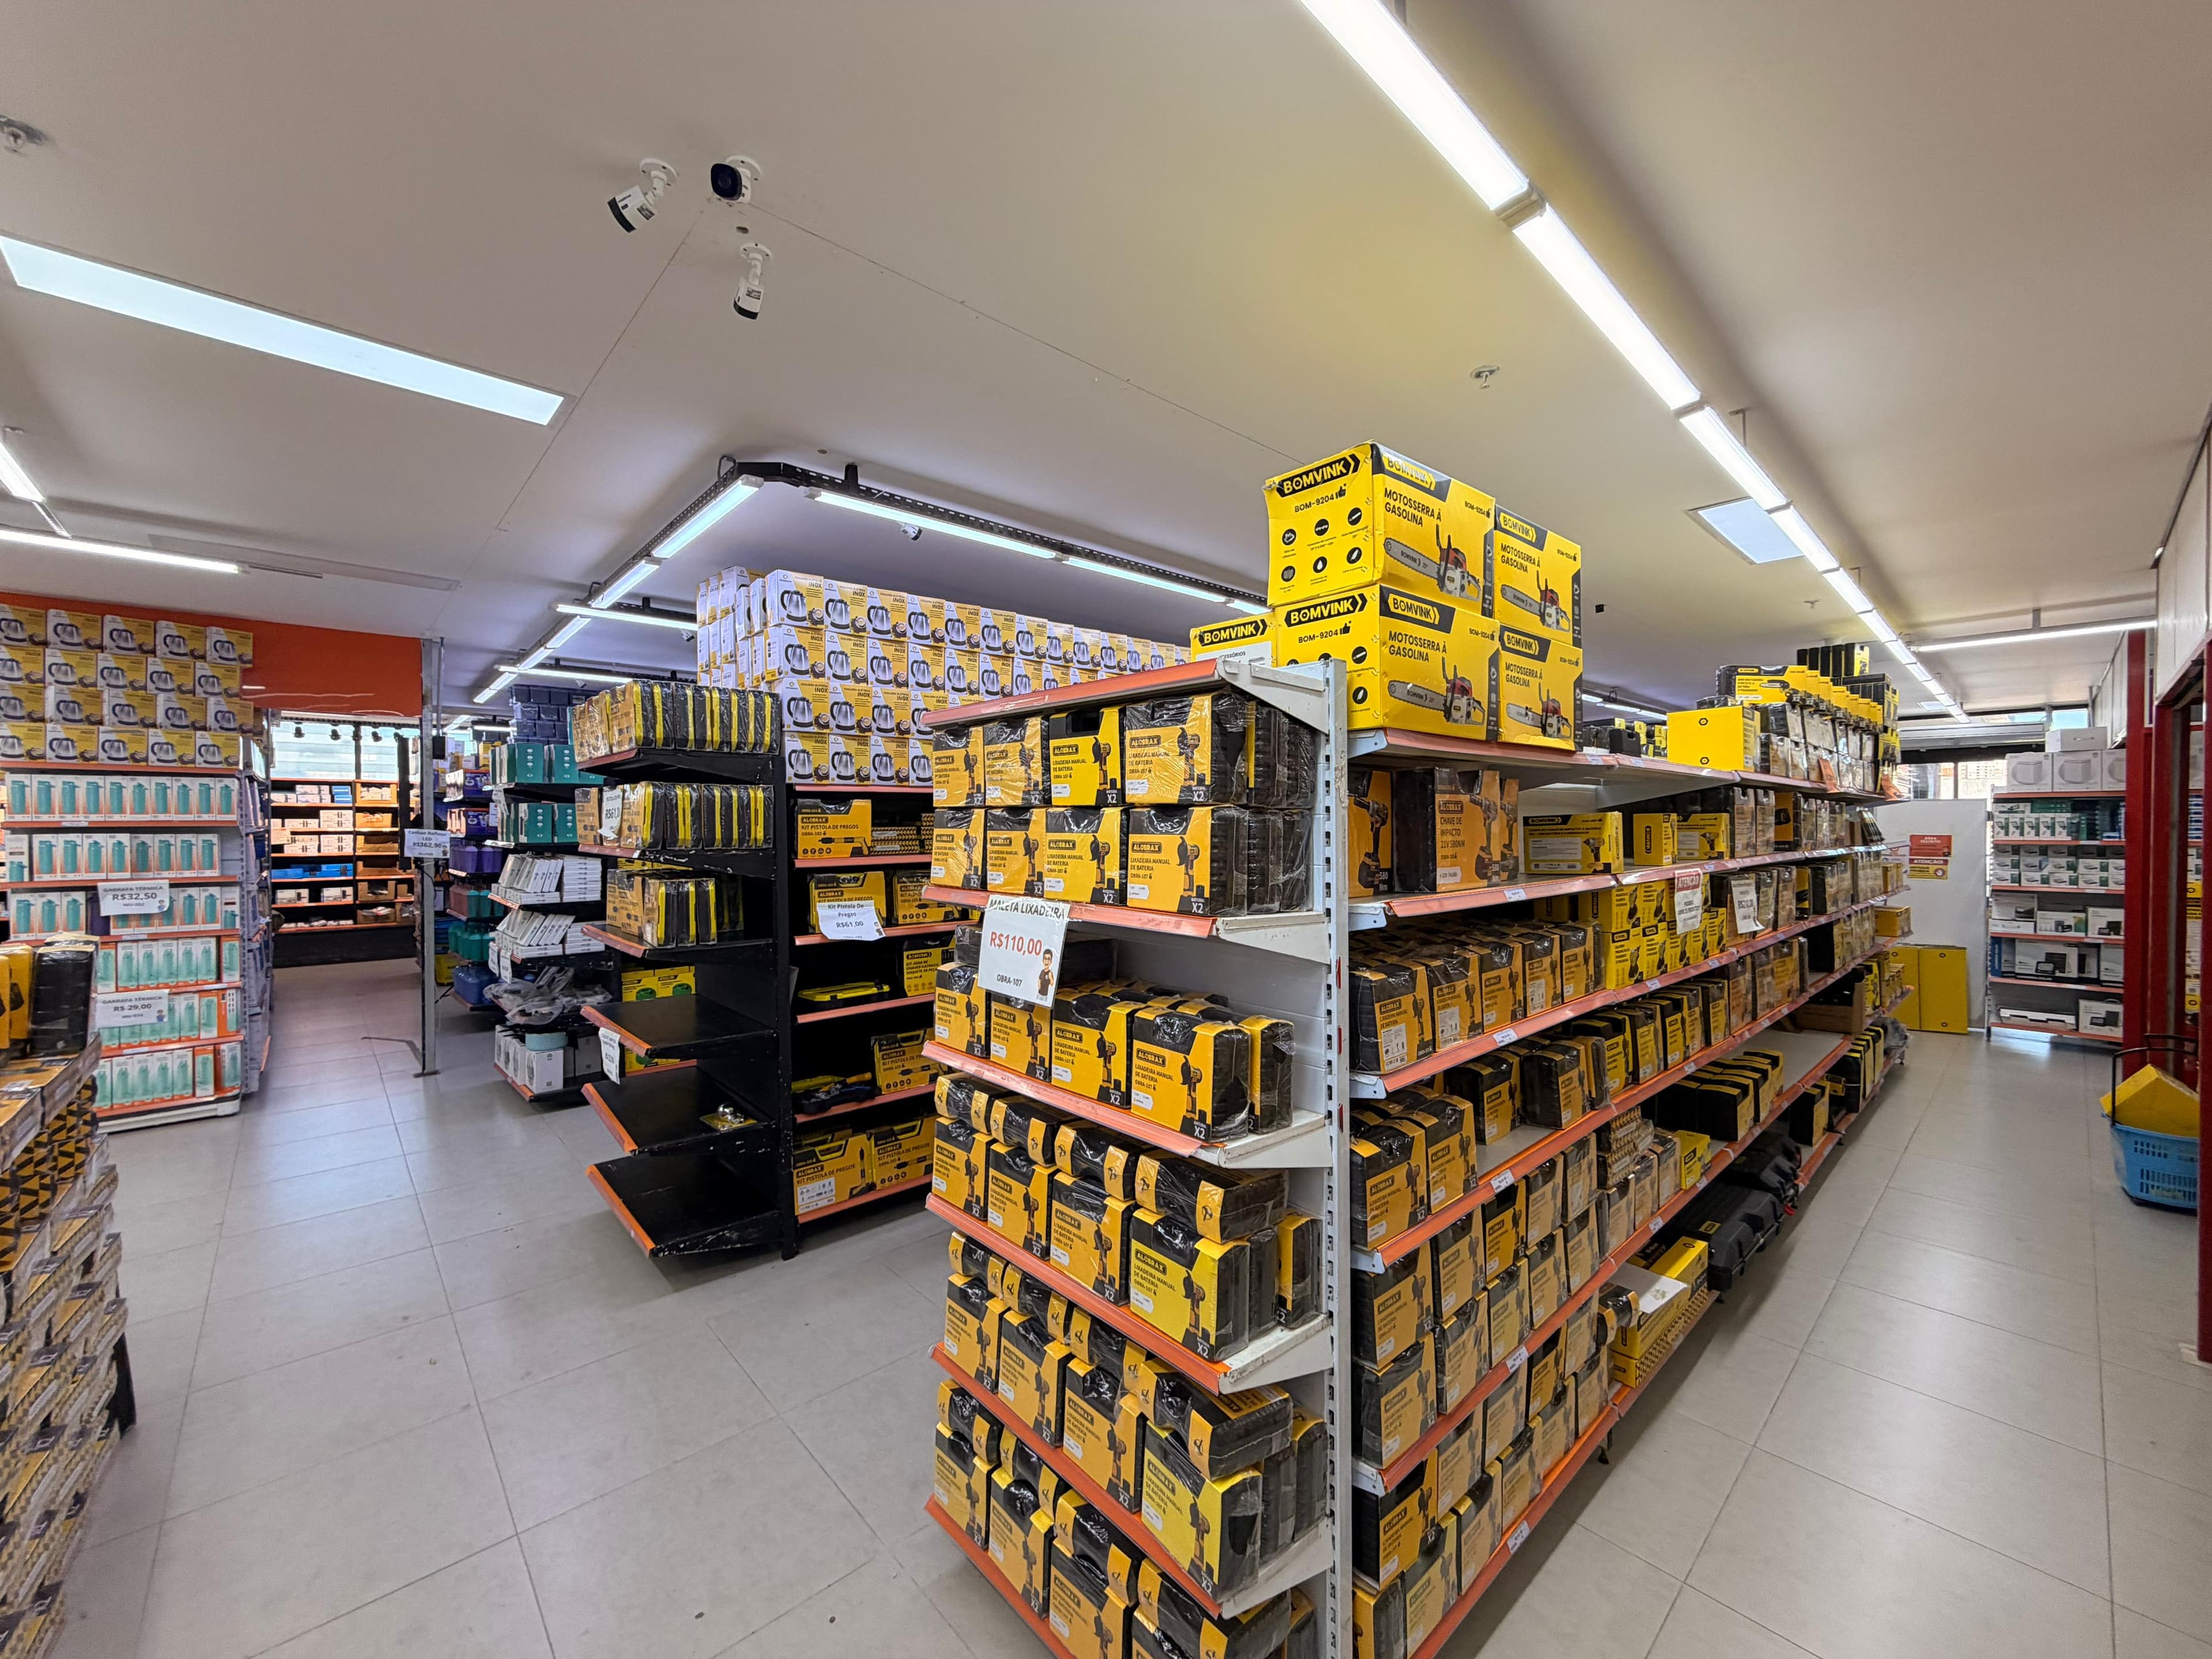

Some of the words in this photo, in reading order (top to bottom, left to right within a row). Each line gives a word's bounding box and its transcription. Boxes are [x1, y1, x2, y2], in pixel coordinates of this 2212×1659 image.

[1283, 460, 1347, 494] BOMVINK
[1387, 458, 1428, 485] BOMVINK
[1294, 494, 1335, 513] BOM-9204
[1384, 487, 1434, 519] MOTOSSERRA
[1436, 507, 1441, 522] À
[1385, 501, 1423, 527] GASOLINA
[1503, 516, 1531, 537] BOMVINK
[1501, 543, 1536, 566] MOTOSSERRA
[1501, 555, 1528, 573] GASOLINA
[1290, 600, 1354, 624] BOMVINK
[1393, 597, 1432, 620] BOMVINK
[1203, 623, 1256, 643] BOMVINK
[1298, 631, 1338, 643] BOM-9204
[1389, 630, 1440, 652] MOTOSSERRA
[1442, 641, 1446, 654] À
[1507, 634, 1533, 652] BOMVINK
[1389, 645, 1429, 662] GASOLINA
[1505, 662, 1538, 679] MOTOSSERRA
[1505, 674, 1530, 688] GASOLINA
[1031, 795, 1039, 804] X2
[1107, 794, 1116, 803] X2
[1193, 791, 1204, 801] X2
[970, 879, 978, 887] X2
[1379, 872, 1388, 880] 580
[1678, 876, 1699, 889] ATENÇÃO
[112, 893, 157, 901] R$32,50
[1034, 886, 1042, 894] X2
[1103, 893, 1113, 904] X2
[990, 899, 1019, 913] MALETA
[1021, 902, 1065, 919] LIXADEIRA
[1192, 903, 1203, 914] X2
[990, 931, 1043, 956] R$110,00
[997, 974, 1022, 987] OBRA-107
[974, 1047, 982, 1055] X2
[1055, 1041, 1073, 1051] LIXADEIRA
[1074, 1046, 1090, 1055] MANUAL
[1060, 1050, 1076, 1058] BATERIA
[891, 1056, 907, 1065] PISTOLA
[1035, 1070, 1044, 1079] X2
[1135, 1063, 1156, 1074] LIXADEIRA
[1156, 1070, 1174, 1081] MANUAL
[1141, 1073, 1158, 1083] BATERIA
[1110, 1094, 1120, 1105] X2
[1194, 1127, 1205, 1139] X2
[888, 1150, 904, 1158] PISTOLA
[912, 1142, 930, 1151] PREGOS
[807, 1172, 827, 1183] PISTOLA
[836, 1164, 855, 1173] PREGOS
[1418, 1210, 1425, 1222] X2
[1032, 1244, 1041, 1257] X2
[1134, 1264, 1156, 1281] LIXADEIRA
[1157, 1275, 1176, 1292] MANUAL
[1140, 1274, 1158, 1289] BATERIA
[1105, 1287, 1114, 1301] X2
[1198, 1344, 1209, 1359] X2
[1119, 1492, 1129, 1508] X2
